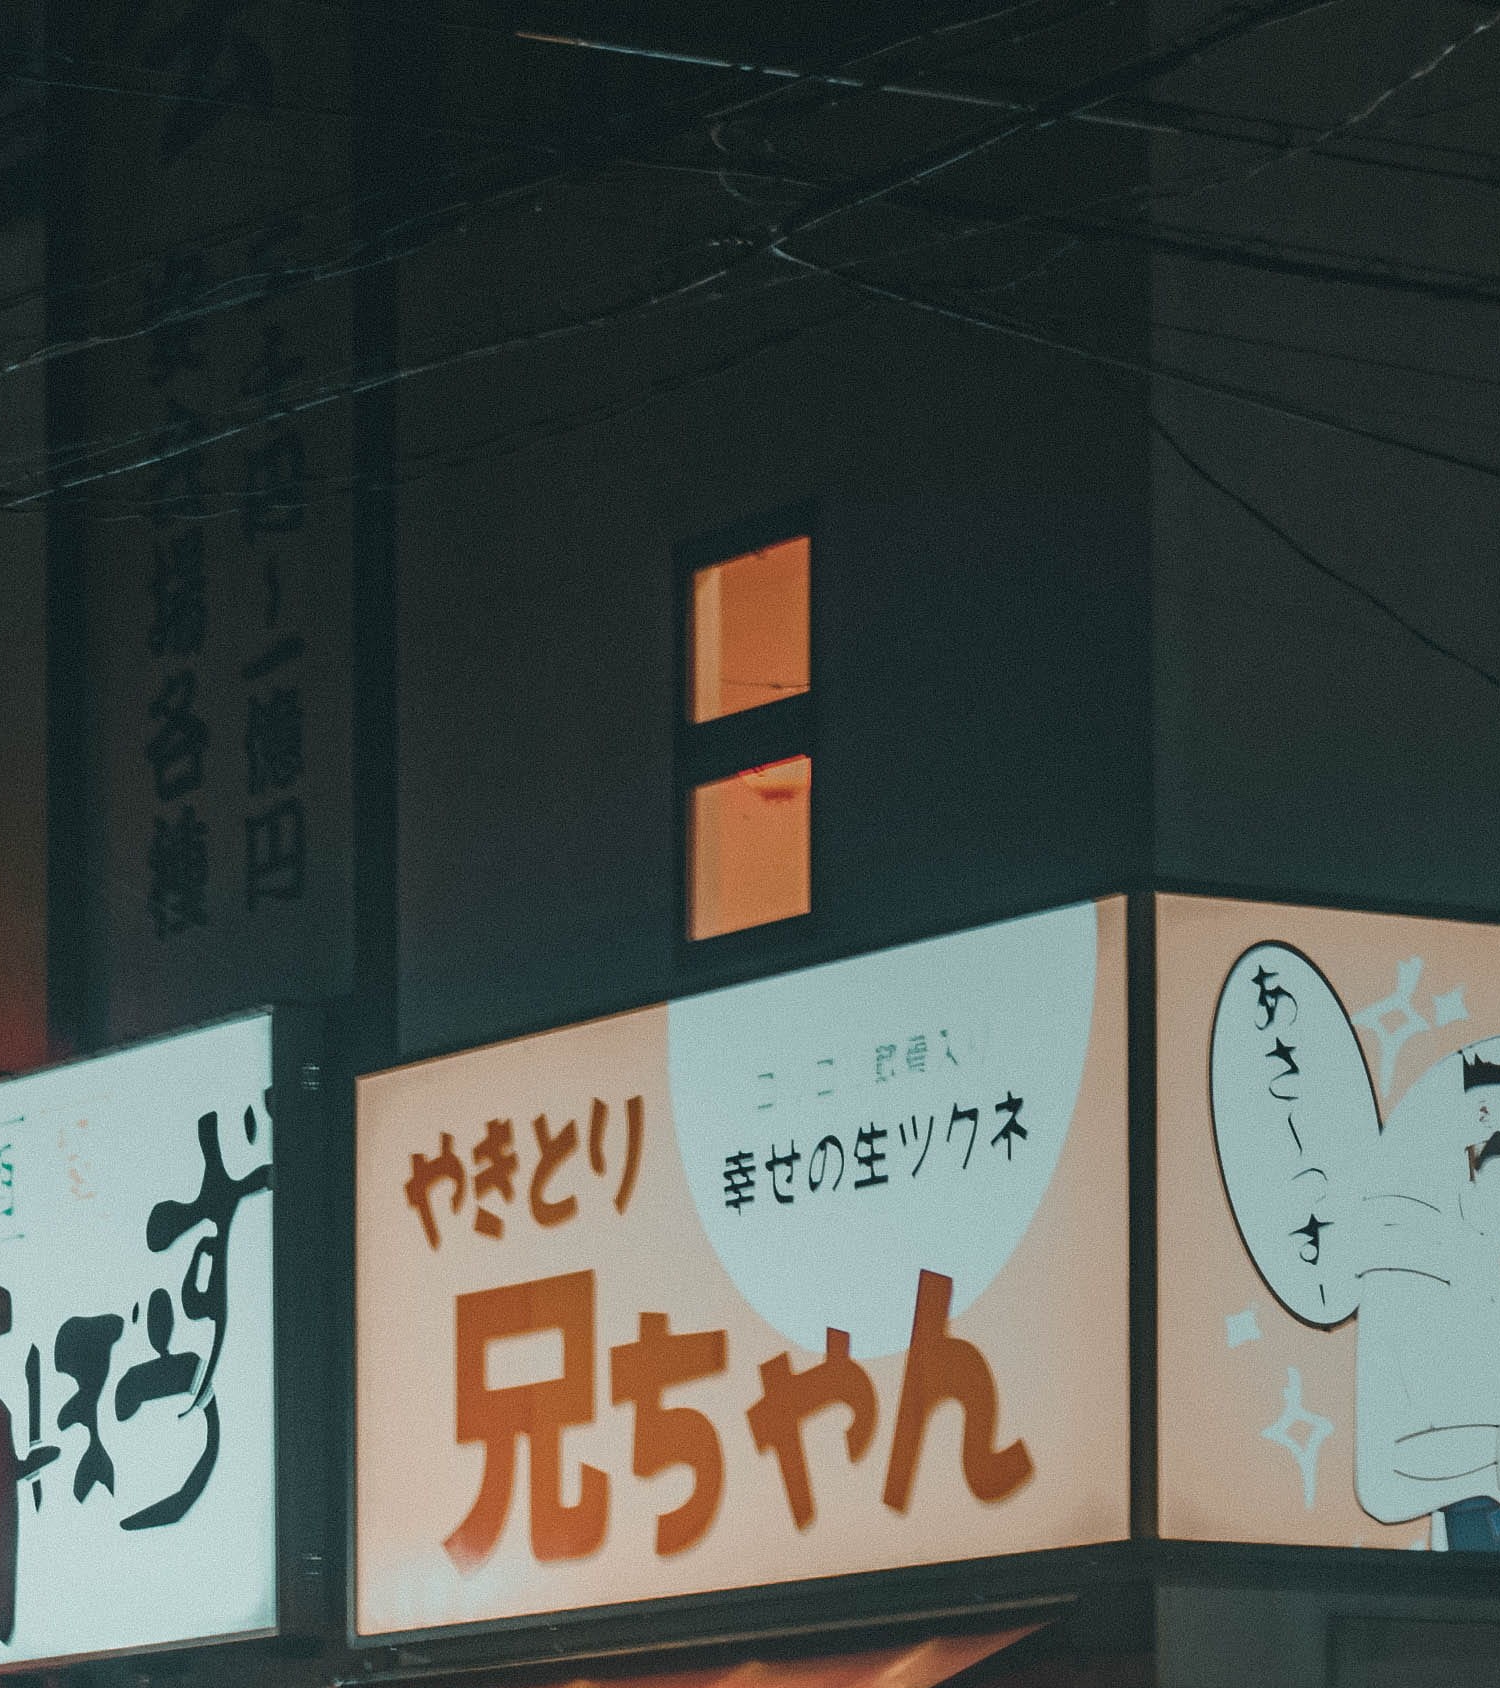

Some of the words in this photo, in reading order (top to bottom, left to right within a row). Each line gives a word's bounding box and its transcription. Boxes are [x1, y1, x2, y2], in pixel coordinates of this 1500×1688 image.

[404, 1094, 646, 1253] やきとり
[722, 1090, 1028, 1217] 幸せの生ツクネ
[443, 1267, 1036, 1575] 兄ちゃん
